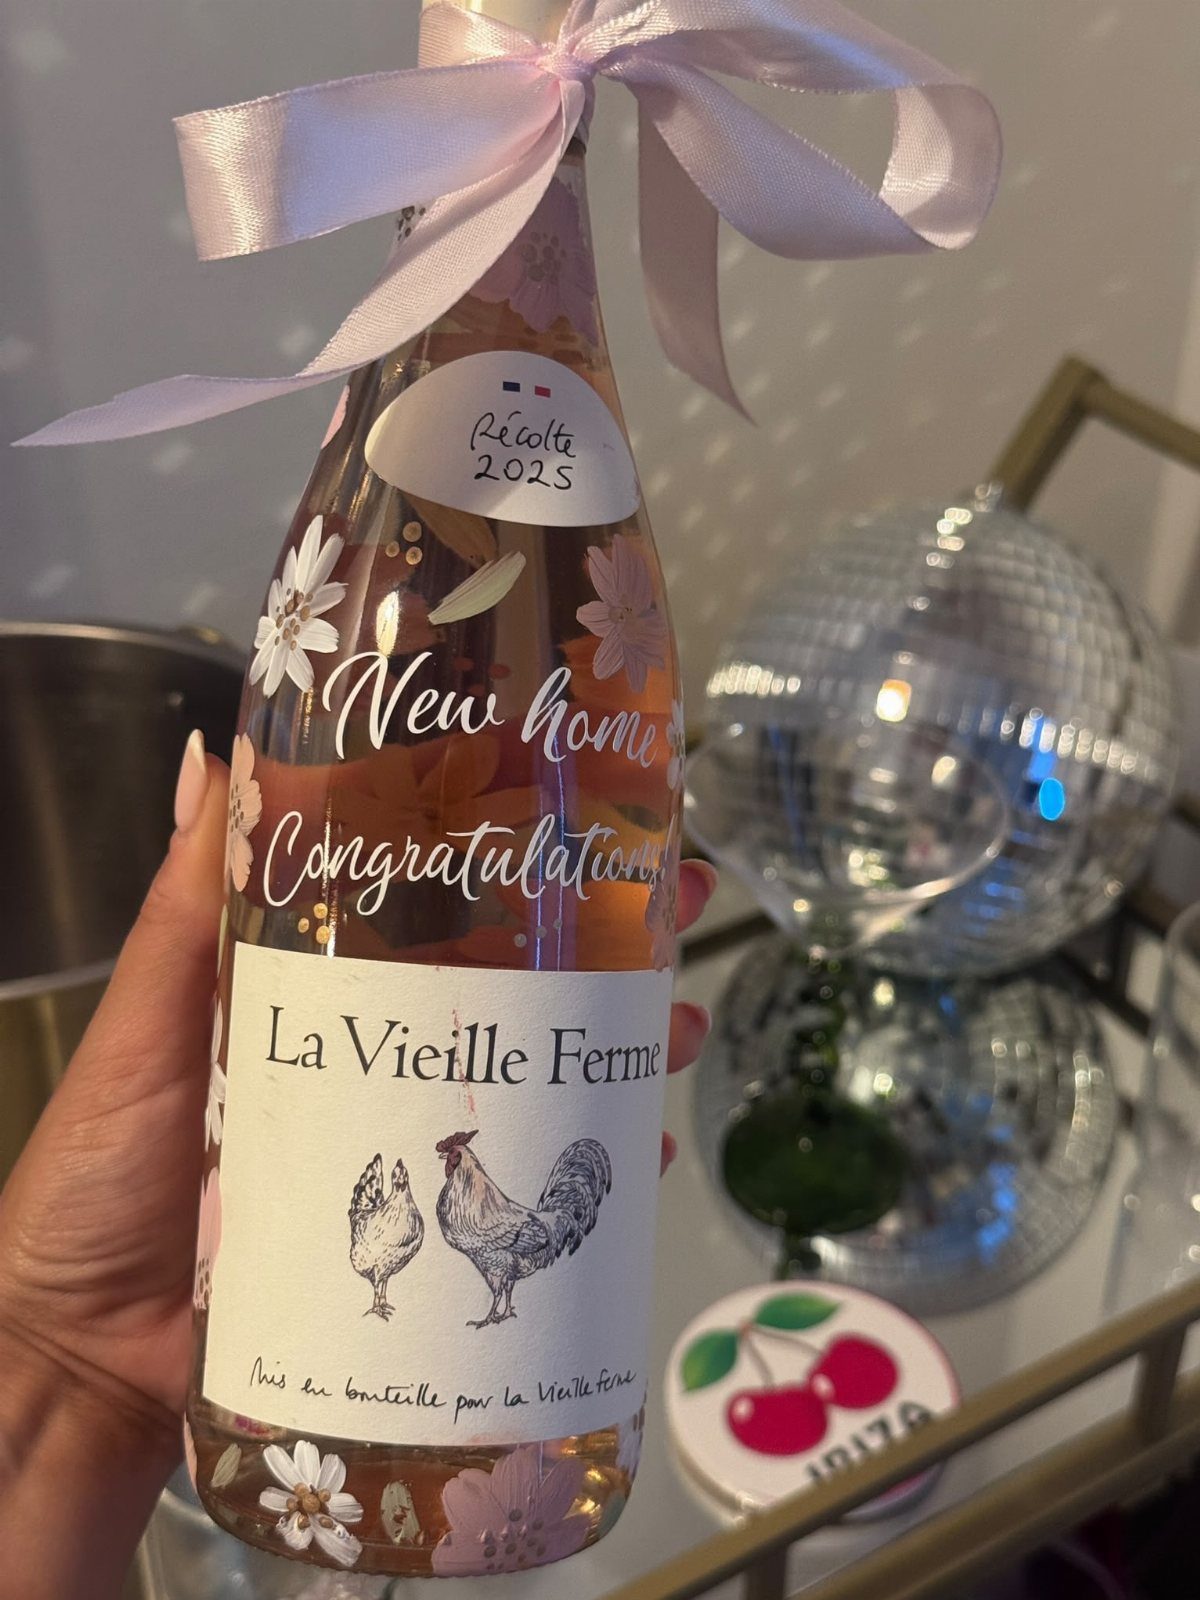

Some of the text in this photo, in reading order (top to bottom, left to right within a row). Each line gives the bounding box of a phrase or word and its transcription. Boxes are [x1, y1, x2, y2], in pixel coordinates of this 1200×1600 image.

[470, 410, 577, 458] Récolte
[473, 454, 574, 490] 2025
[321, 651, 660, 768] New home
[265, 1005, 661, 1085] La Vieille Ferme
[250, 1356, 286, 1389] Mis
[300, 1377, 333, 1397] en
[345, 1376, 447, 1408] bouteille
